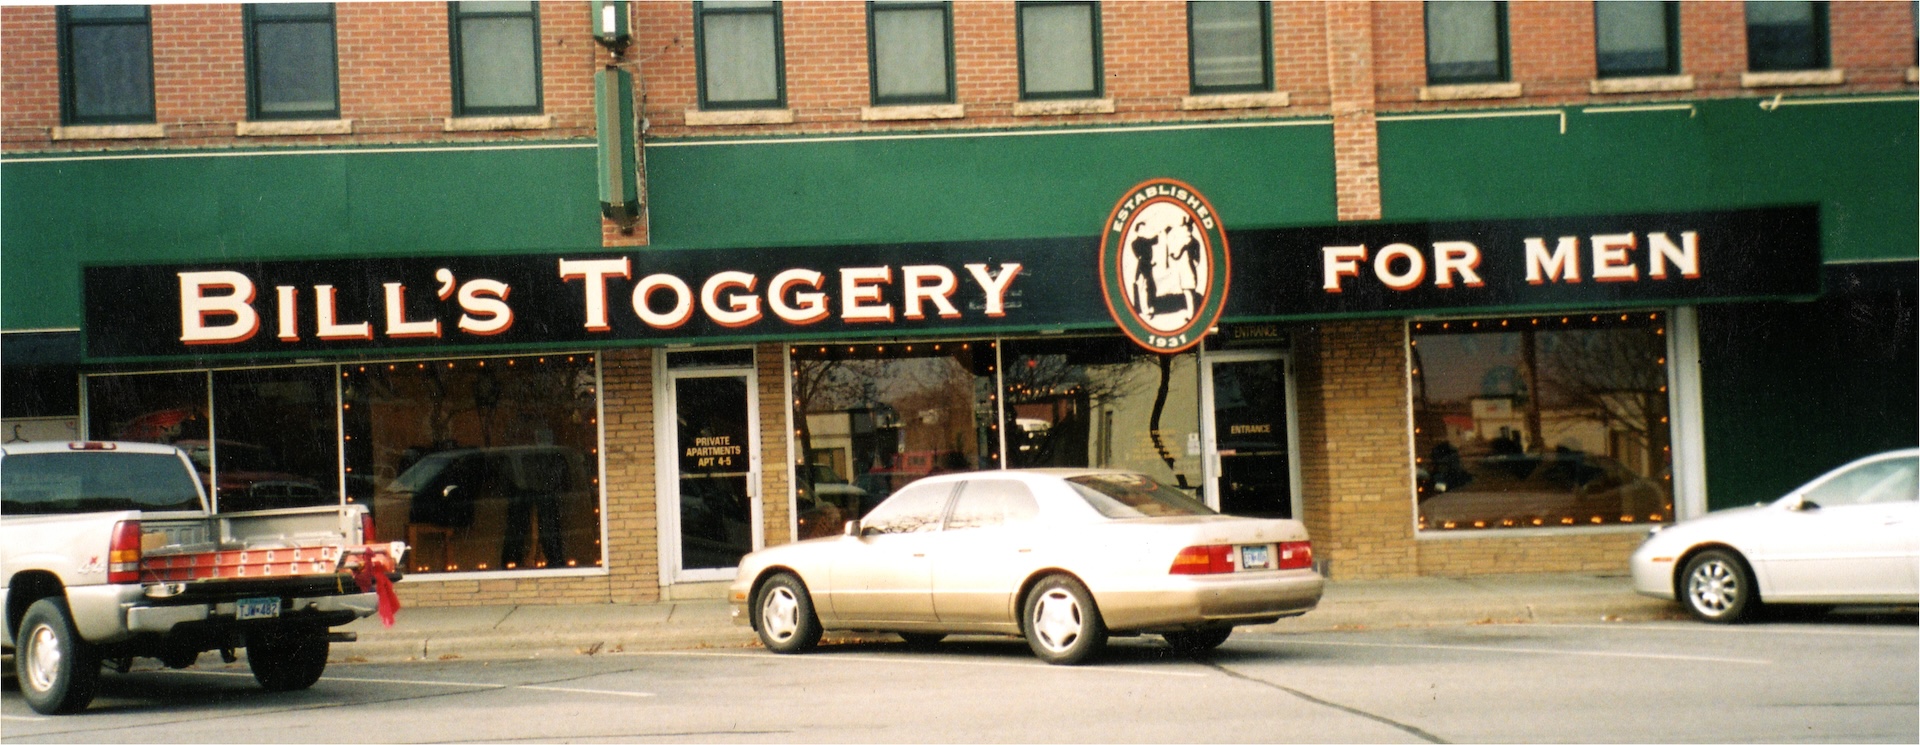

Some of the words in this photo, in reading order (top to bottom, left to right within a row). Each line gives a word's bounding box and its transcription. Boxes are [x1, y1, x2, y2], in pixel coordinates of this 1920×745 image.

[1113, 185, 1214, 232] ESTABLISHED
[178, 268, 513, 344] BILL'S
[559, 256, 1023, 331] TOGGERY
[1323, 241, 1484, 292] FOR
[1524, 231, 1699, 285] MEN
[1234, 325, 1278, 338] ENTRANCE
[1148, 334, 1187, 348] 1931
[1230, 424, 1271, 434] ENTRANCE
[695, 436, 730, 446] PRIVATE
[686, 446, 741, 457] APARTMENTS
[698, 457, 714, 466] APT
[718, 456, 731, 466] 4-5
